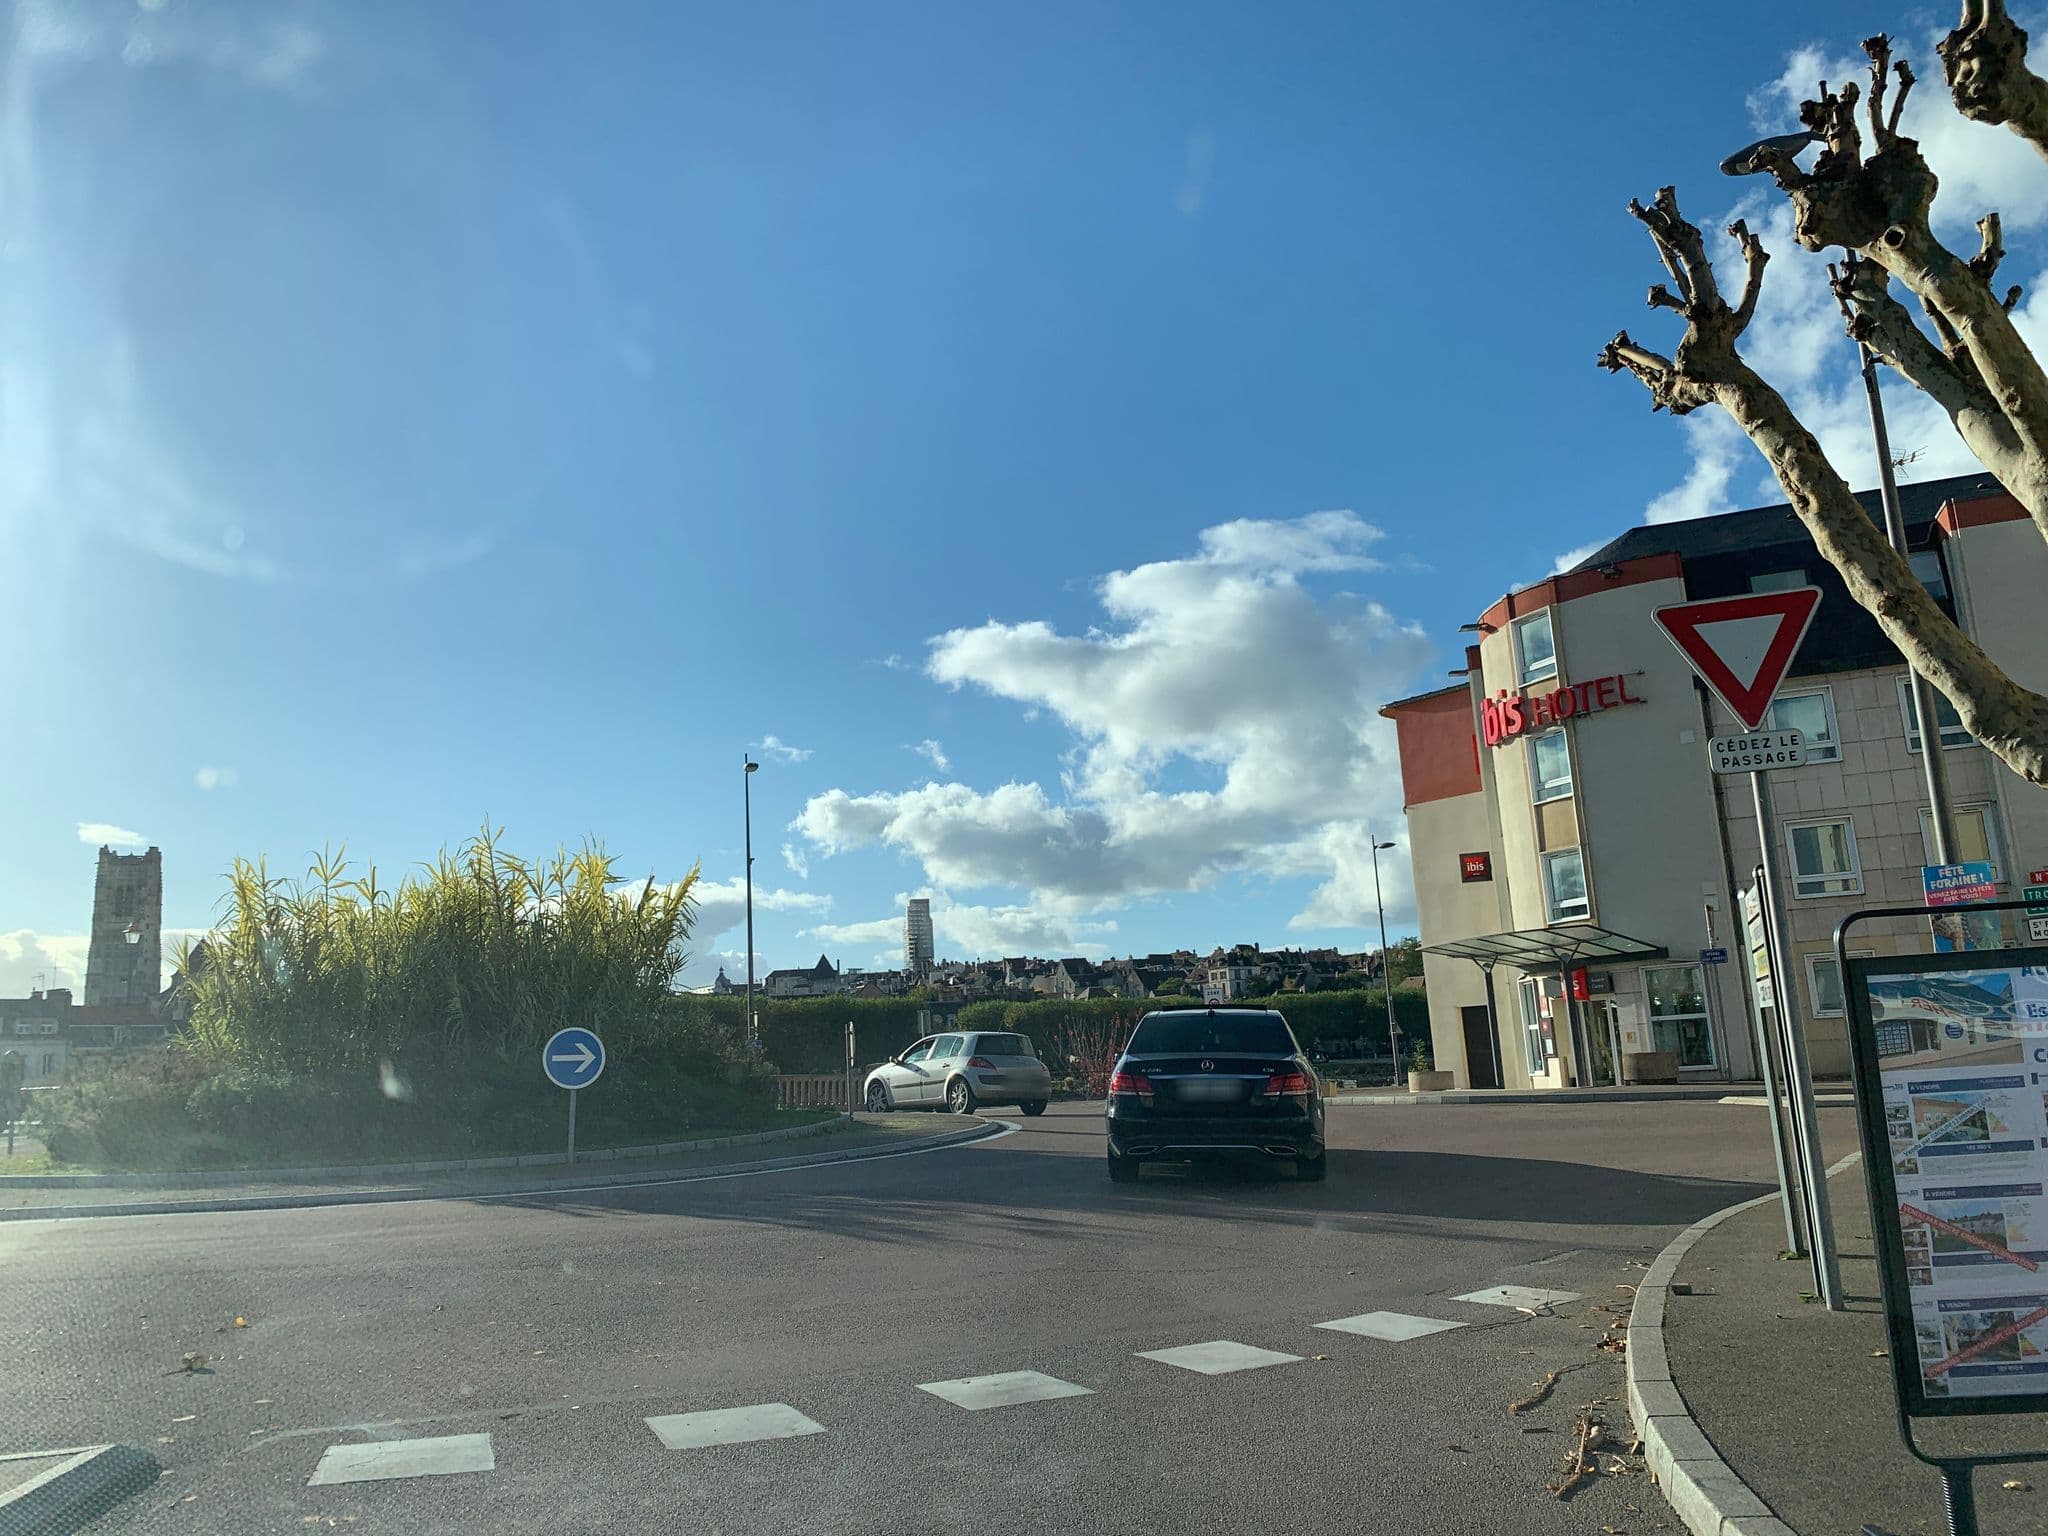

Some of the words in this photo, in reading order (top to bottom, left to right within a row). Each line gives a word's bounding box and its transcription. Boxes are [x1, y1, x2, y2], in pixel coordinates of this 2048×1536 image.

[1533, 674, 1641, 727] HOTEL
[1716, 737, 1771, 753] CÉDEZ
[1780, 734, 1798, 747] LE
[1721, 750, 1798, 768] PASSAGE
[1466, 861, 1484, 872] ibis
[1938, 865, 1965, 878] FÊTE
[1930, 873, 1978, 890] FORAINE
